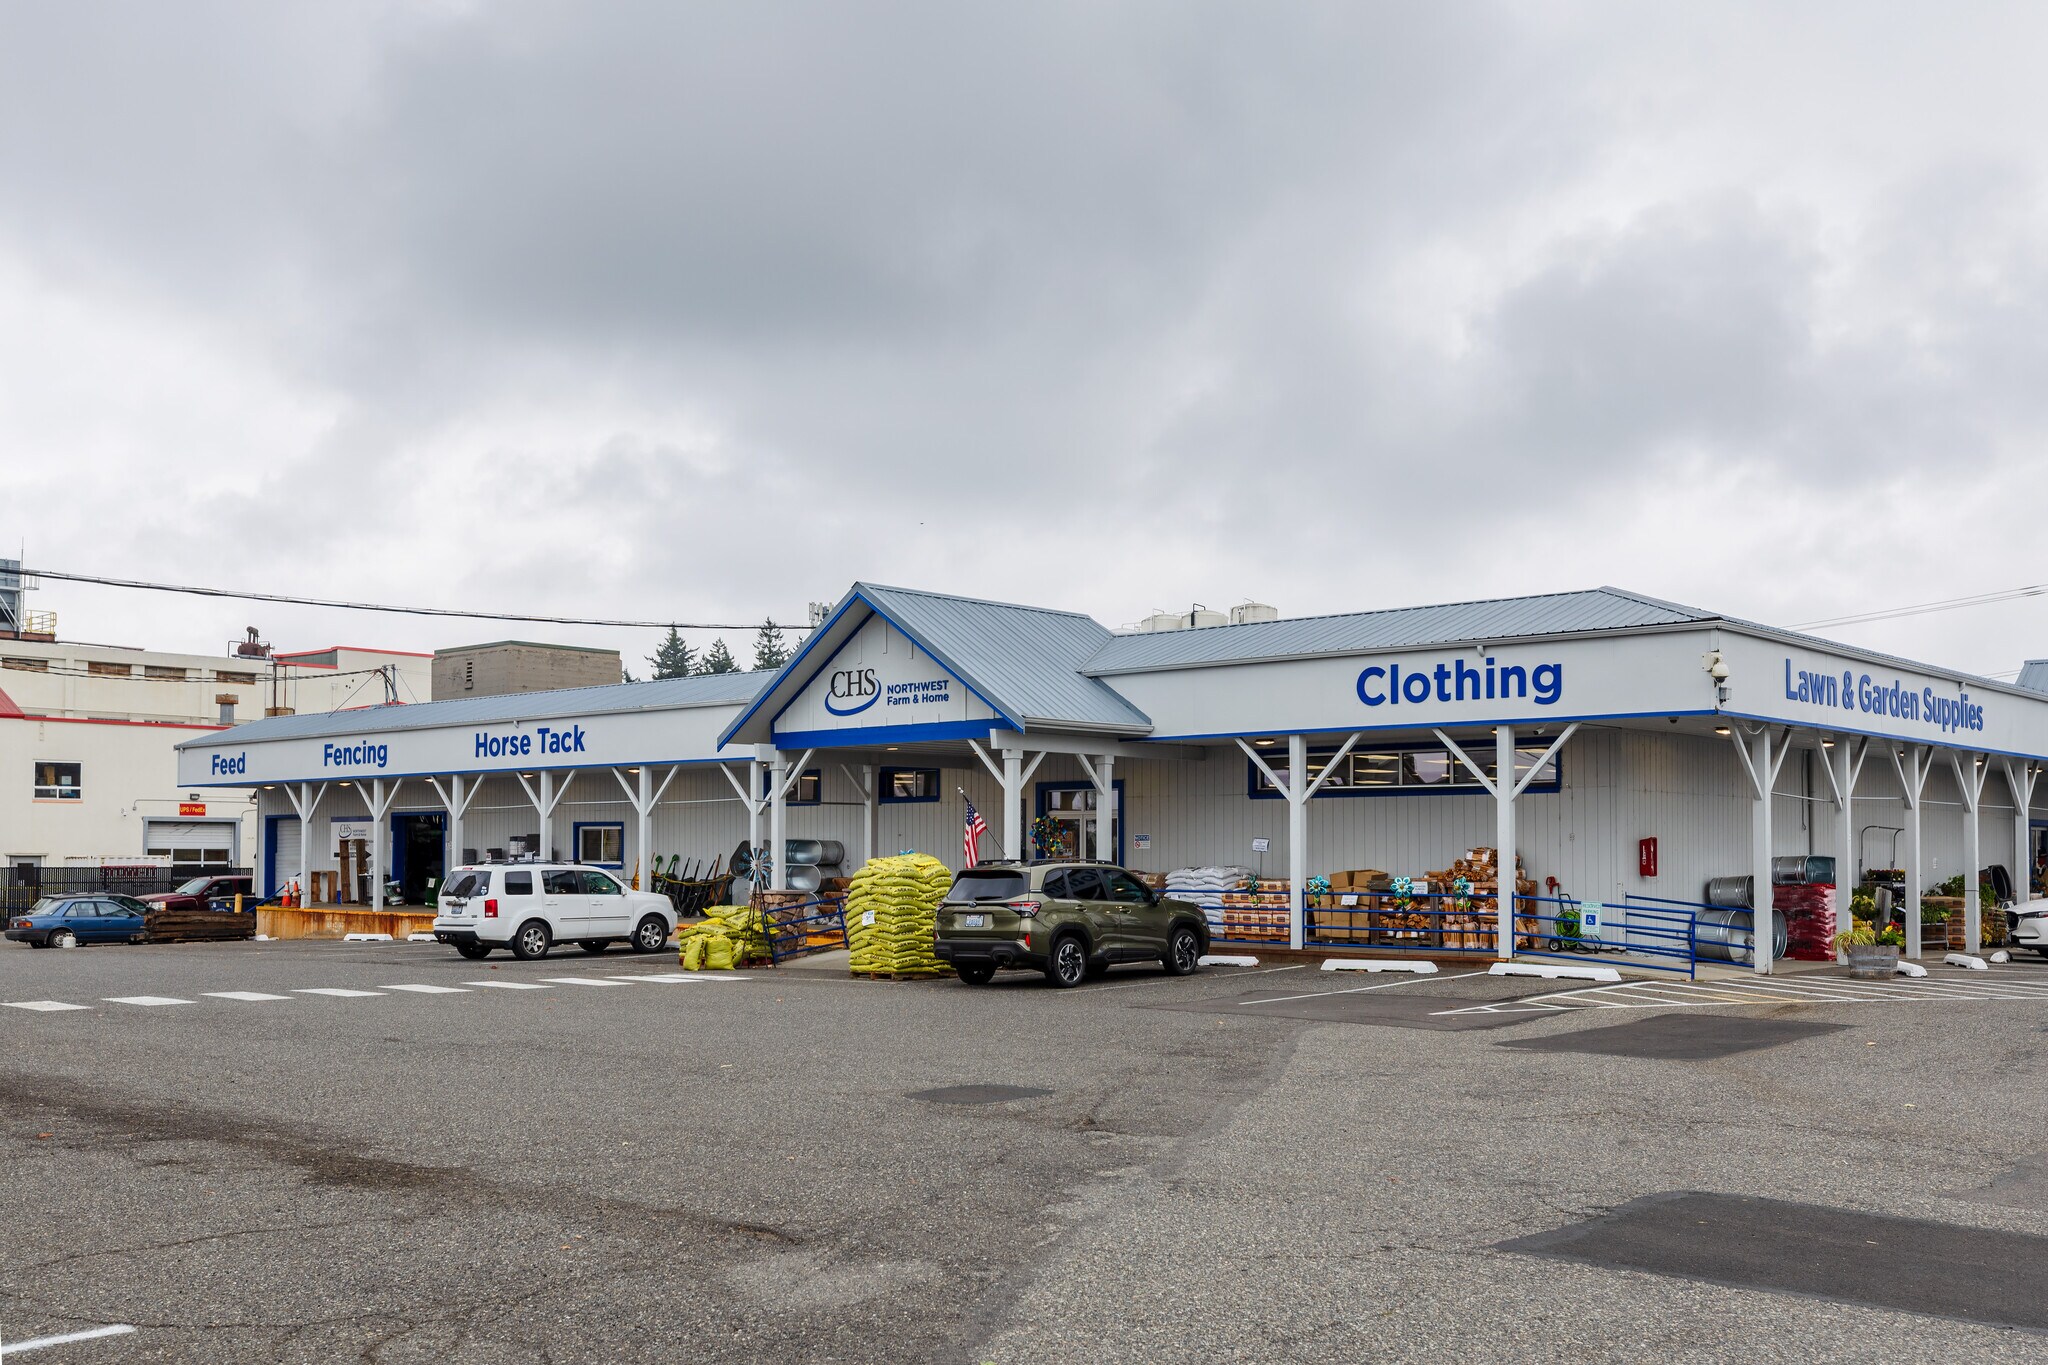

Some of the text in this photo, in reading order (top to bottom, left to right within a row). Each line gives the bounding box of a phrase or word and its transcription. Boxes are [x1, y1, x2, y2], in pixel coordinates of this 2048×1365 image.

[831, 669, 876, 698] CHS
[886, 680, 949, 695] NORTHWEST
[1355, 656, 1564, 707] Clothing
[1785, 658, 1984, 734] Lawn & Garden Supplies
[887, 692, 950, 706] Farm & Home
[323, 740, 389, 770] Fencing
[474, 724, 586, 759] Horse Tack
[211, 751, 247, 776] Feed
